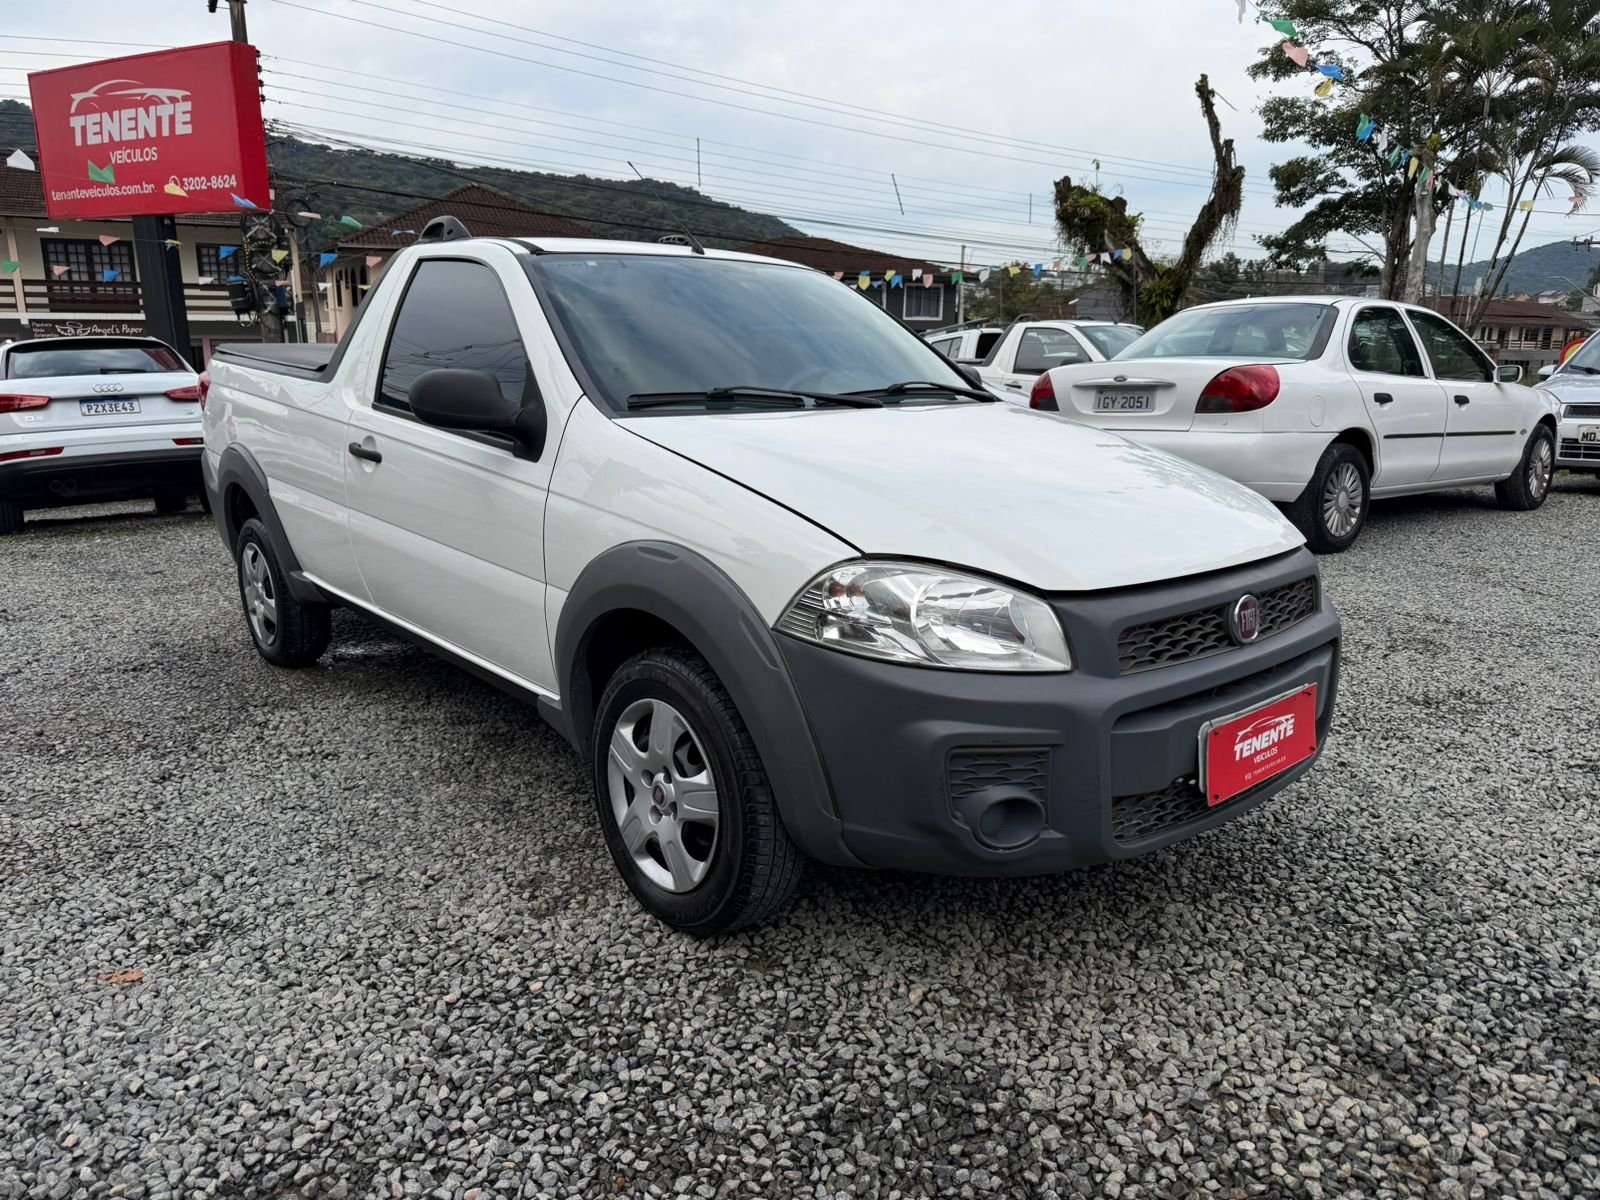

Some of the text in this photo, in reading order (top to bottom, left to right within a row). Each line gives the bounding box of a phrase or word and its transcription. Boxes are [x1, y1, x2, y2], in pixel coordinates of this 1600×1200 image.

[70, 101, 192, 146] TENENTE
[110, 147, 157, 164] VEÍCULOS
[182, 174, 237, 190] 3202-8624
[91, 324, 143, 336] Angel's Paper
[87, 402, 135, 413] PZX3E43
[1234, 717, 1295, 761] TENENTE
